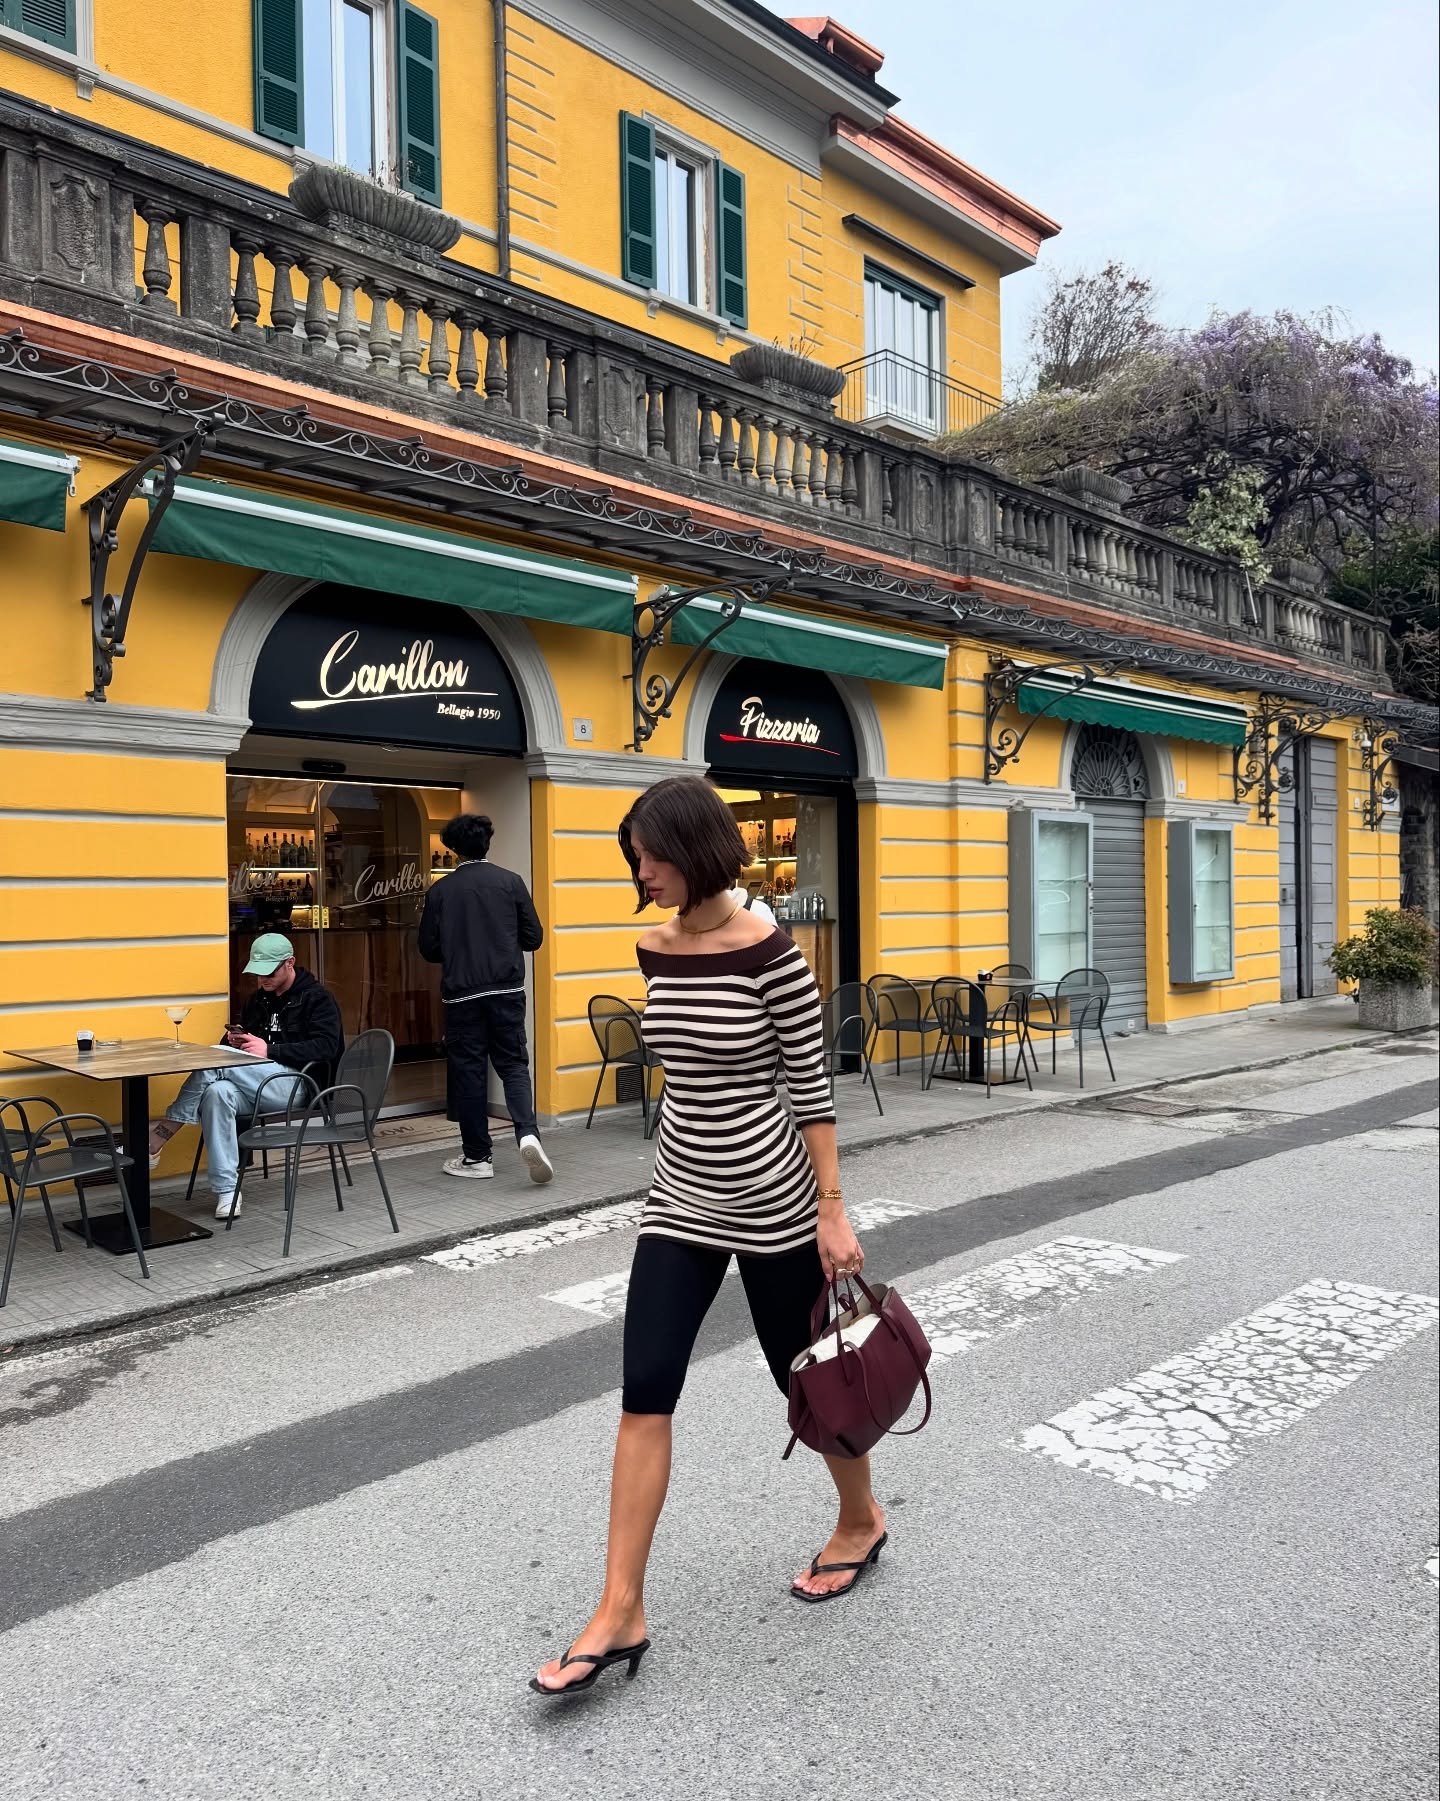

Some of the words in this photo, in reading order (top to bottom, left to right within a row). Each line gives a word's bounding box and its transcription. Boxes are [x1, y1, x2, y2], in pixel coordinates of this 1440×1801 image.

[320, 630, 469, 698] Carillon
[437, 703, 475, 720] Bellagio
[477, 707, 501, 720] 1950
[740, 696, 820, 744] Pizzeria
[580, 724, 587, 734] 8
[229, 860, 277, 893] illon
